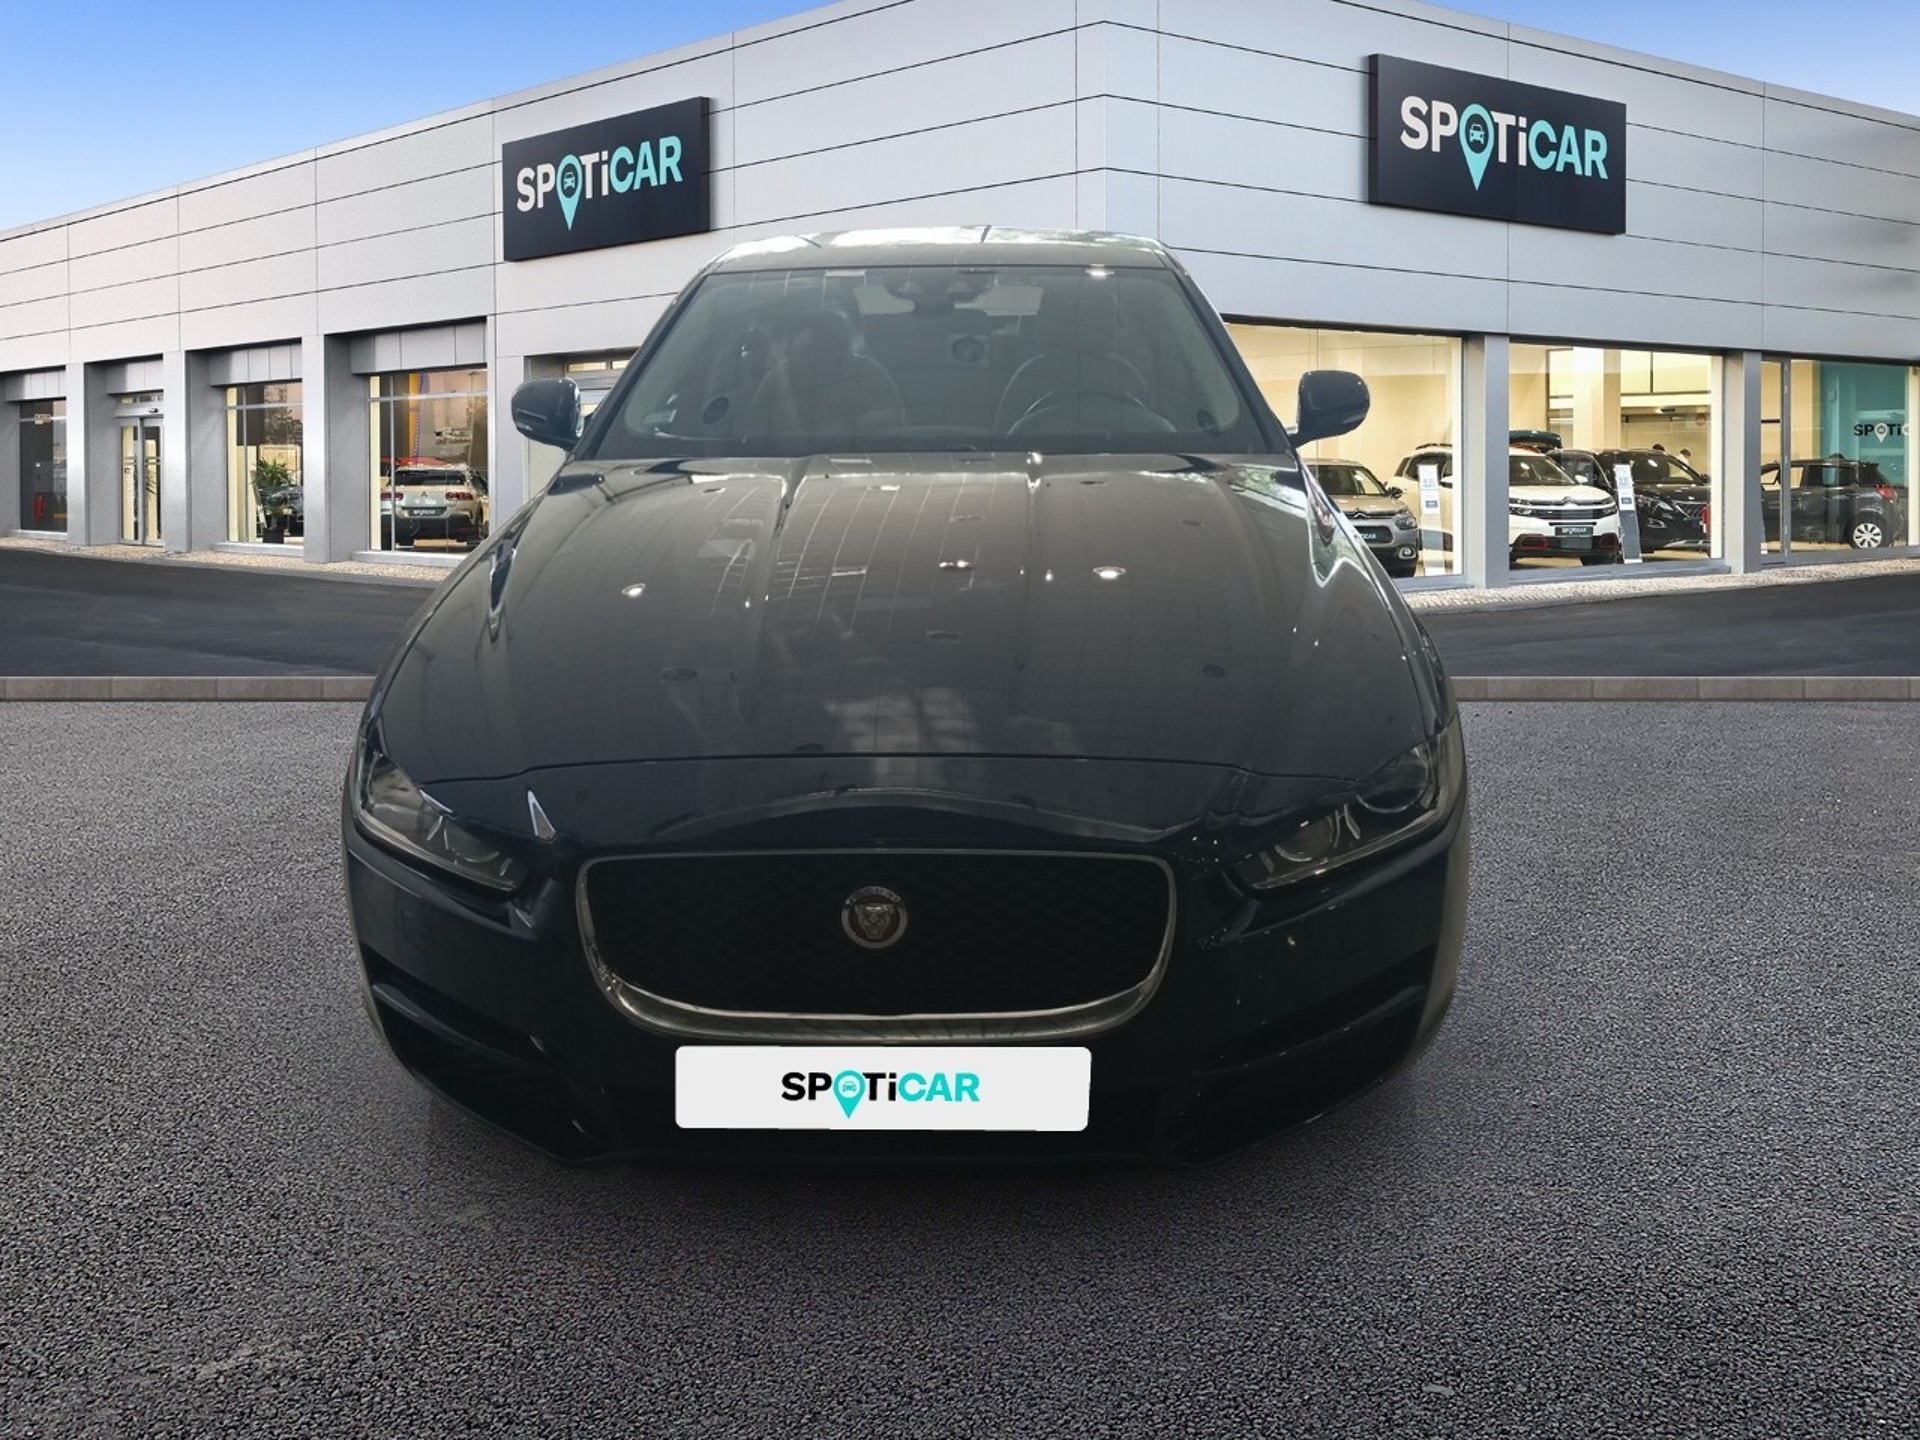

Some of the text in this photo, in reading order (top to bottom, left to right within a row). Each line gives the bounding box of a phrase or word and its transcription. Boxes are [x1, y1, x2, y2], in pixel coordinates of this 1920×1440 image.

[516, 135, 683, 231] SPOTiCAR
[1400, 95, 1609, 191] SPOTiCAR
[781, 1069, 980, 1119] SPOTiCAR
